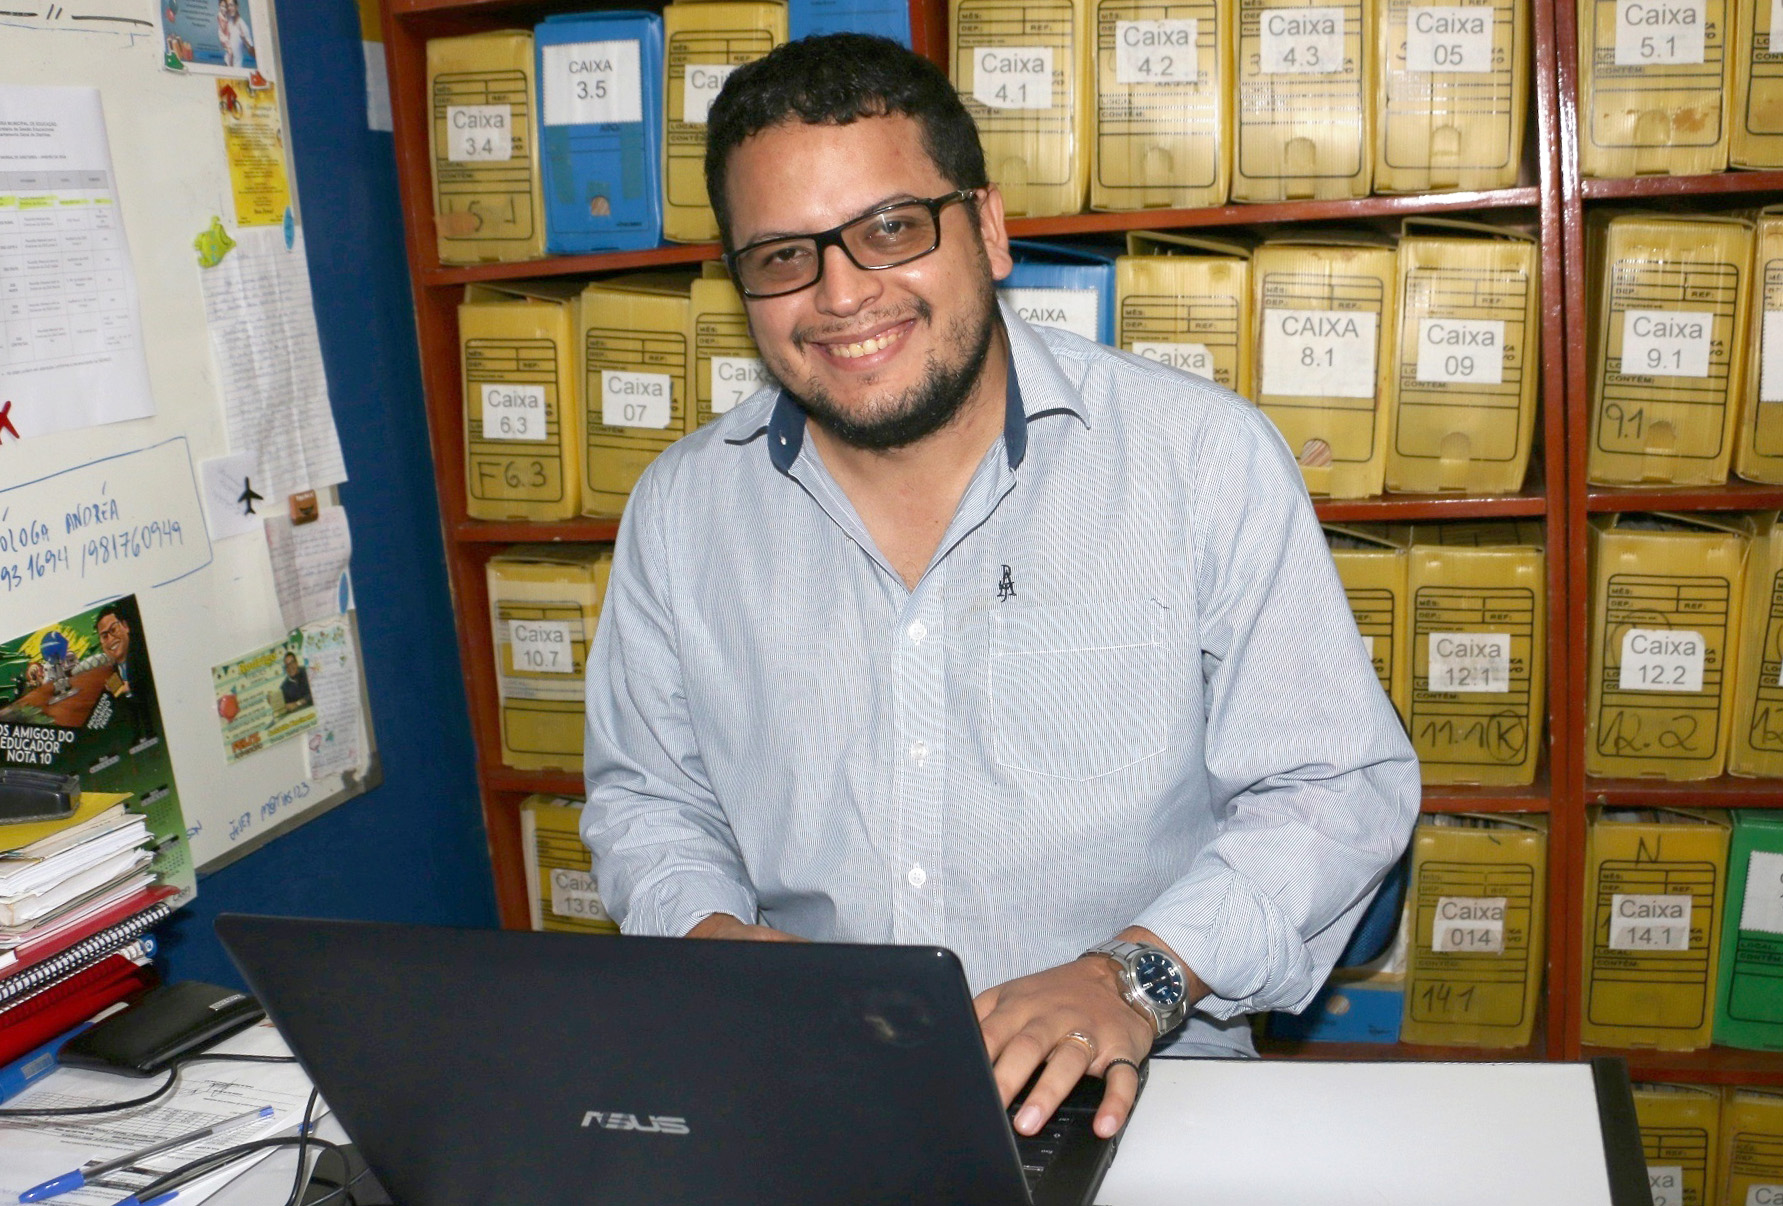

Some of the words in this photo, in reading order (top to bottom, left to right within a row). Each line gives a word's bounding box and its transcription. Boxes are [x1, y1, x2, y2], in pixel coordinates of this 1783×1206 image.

[1416, 12, 1484, 34] Caixa
[1625, 4, 1697, 26] Caixa
[1268, 15, 1335, 36] Caixa
[1124, 26, 1189, 46] Caixa
[1283, 46, 1319, 66] 4.3
[1434, 45, 1463, 65] 05
[1640, 37, 1677, 58] 5.1
[568, 59, 612, 73] CAIXA
[981, 53, 1045, 73] Caixa
[1138, 56, 1173, 76] 4.2
[691, 70, 728, 89] Cai
[577, 81, 607, 99] 3.5
[995, 83, 1027, 102] 4.1
[453, 111, 505, 129] Caixa
[465, 138, 493, 155] 3.4
[1017, 308, 1067, 323] CAIXA
[1282, 316, 1359, 338] CAIXA
[1427, 324, 1494, 346] Caixa
[1633, 316, 1703, 339] Caixa
[1301, 347, 1333, 366] 8.1
[1445, 356, 1474, 376] 09
[1647, 348, 1681, 369] 9.1
[608, 376, 662, 396] Caixa
[488, 390, 538, 408] Caixa
[624, 404, 647, 422] 07
[1605, 403, 1644, 439] 9.1
[500, 416, 528, 434] 6.3
[515, 624, 564, 642] Caixa
[1437, 638, 1501, 658] Caixa
[1631, 634, 1696, 656] Caixa
[524, 650, 559, 667] 10.7
[1445, 667, 1491, 686] 12.1
[1639, 665, 1686, 685] 12.2
[12, 726, 55, 740] AMIGOS
[58, 730, 74, 743] DO
[0, 737, 60, 753] EDUCADOR
[7, 750, 37, 763] NOTA
[40, 753, 52, 764] 10
[565, 898, 599, 915] 13.6
[1442, 902, 1503, 920] Caixa
[1619, 900, 1683, 918] Caixa
[1451, 928, 1491, 946] 014
[1627, 928, 1671, 944] 14.1
[581, 1111, 690, 1135] ASUS
